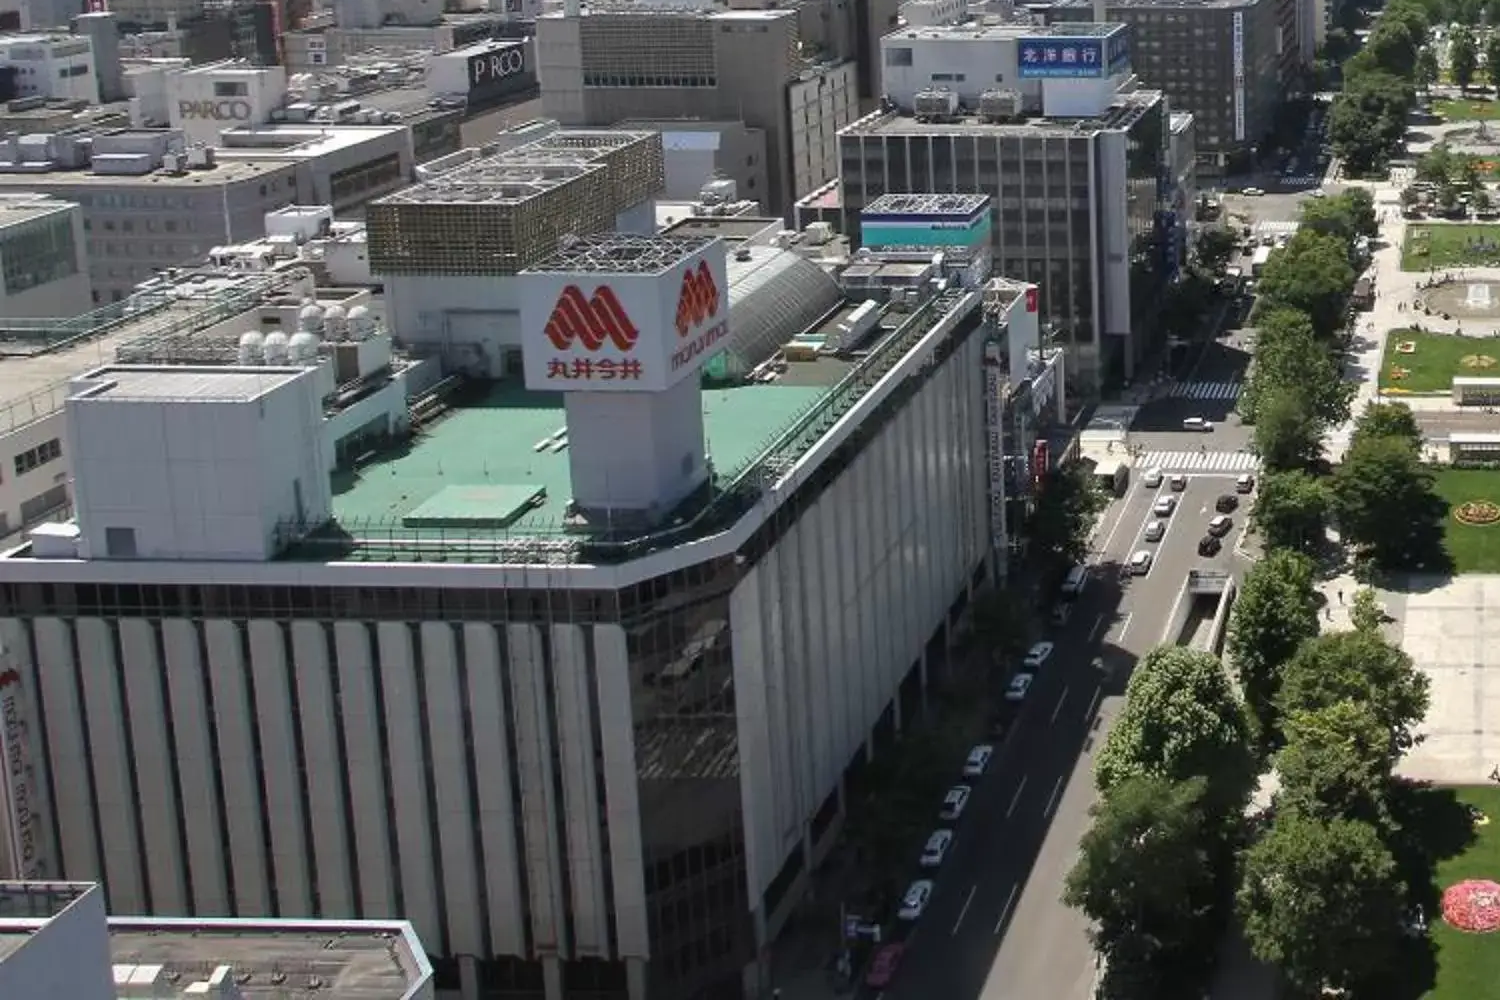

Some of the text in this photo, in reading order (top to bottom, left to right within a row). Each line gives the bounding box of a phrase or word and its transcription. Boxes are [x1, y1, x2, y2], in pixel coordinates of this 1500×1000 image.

[474, 49, 523, 85] PRCO
[178, 100, 252, 121] PARCO
[547, 357, 643, 380] 丸井今井
